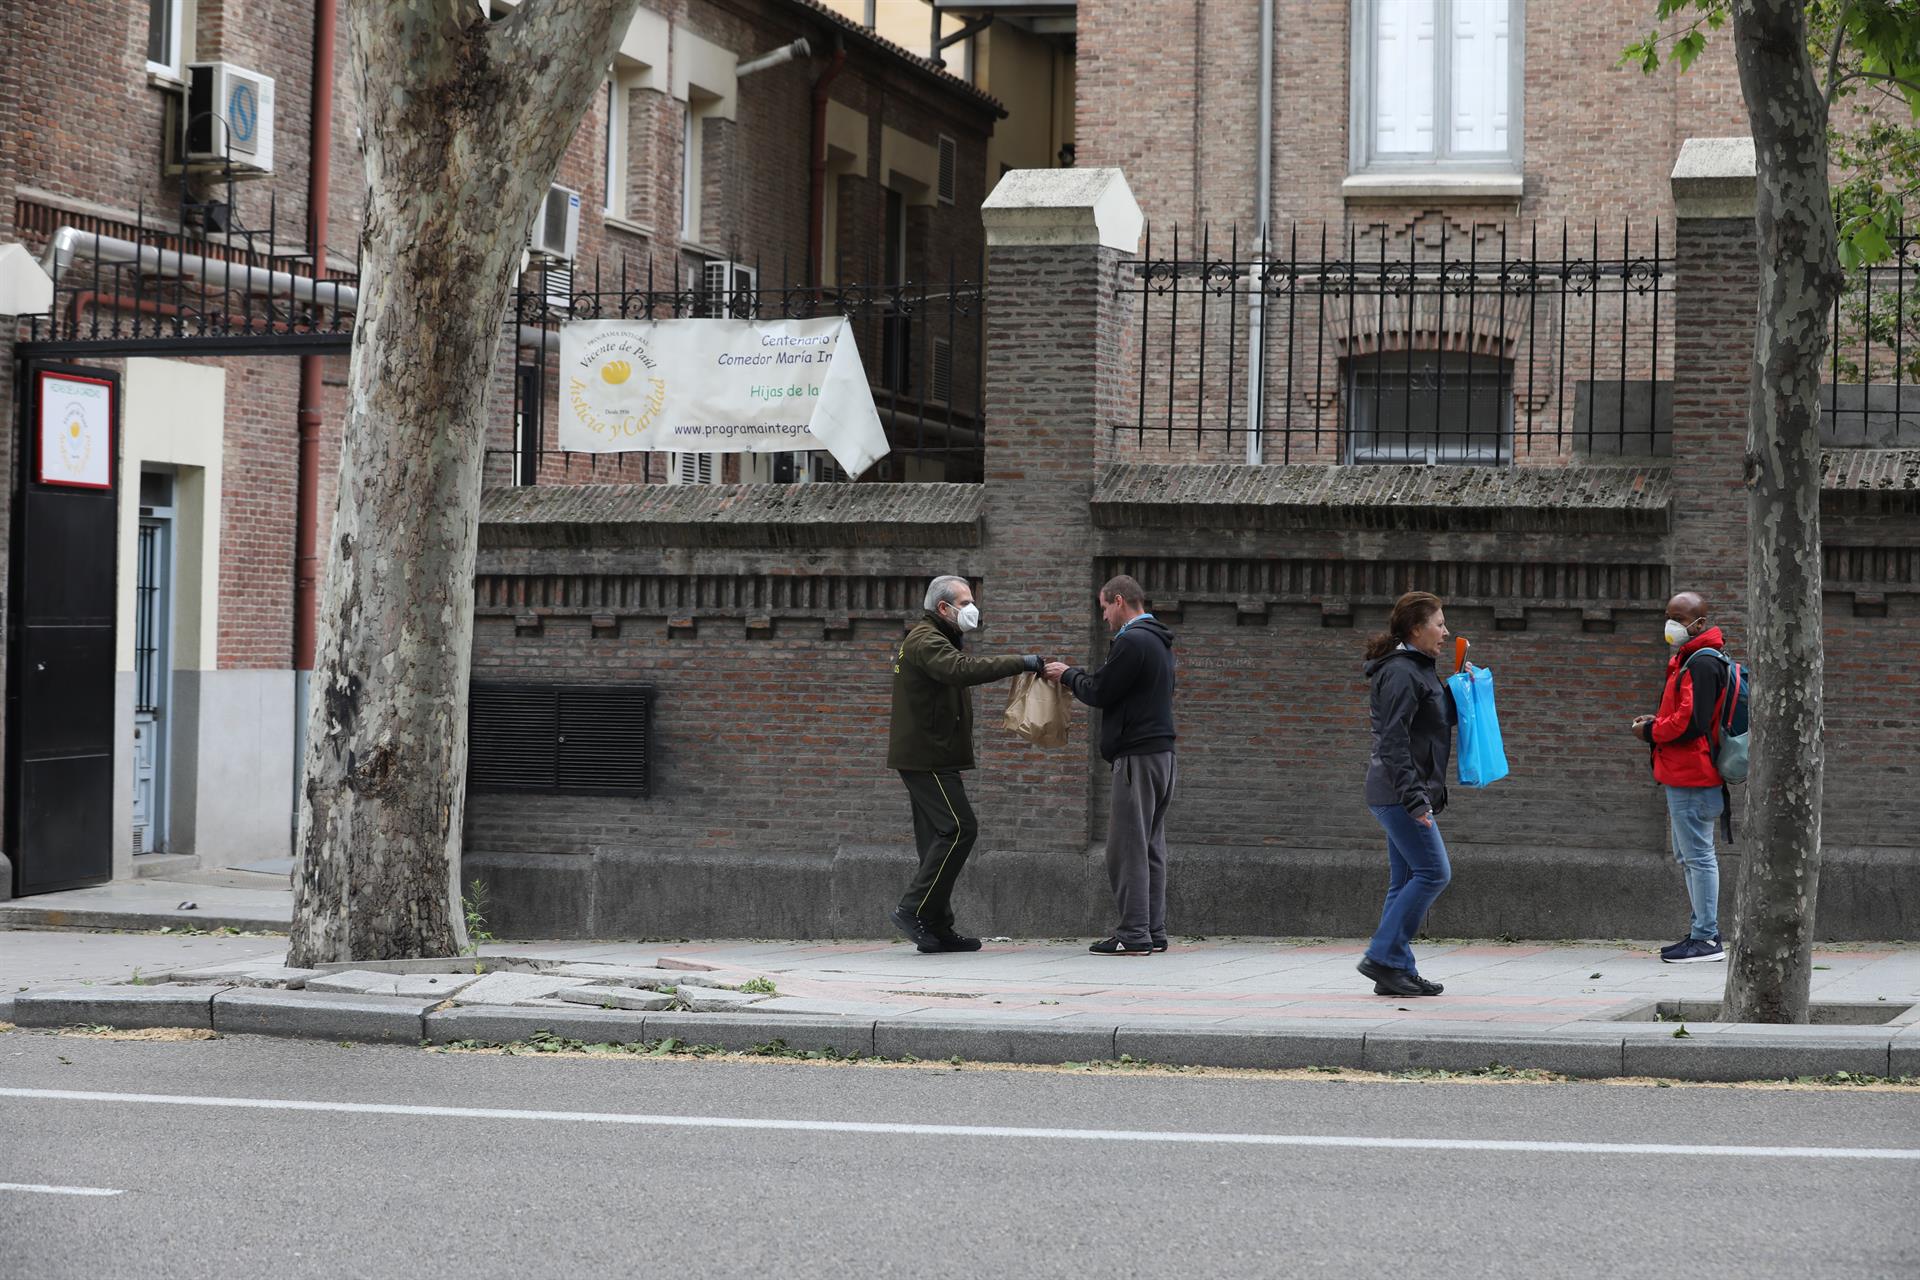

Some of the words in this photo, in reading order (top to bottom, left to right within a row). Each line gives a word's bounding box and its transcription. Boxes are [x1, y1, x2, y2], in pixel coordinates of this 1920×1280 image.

[587, 331, 619, 346] PROGRAMA
[620, 331, 650, 346] INTEGRAL
[761, 334, 830, 346] Centenario
[580, 343, 616, 368] Vicente
[618, 340, 632, 352] de
[633, 346, 657, 369] Paúl
[718, 352, 773, 366] Comedor
[776, 350, 812, 364] María
[750, 384, 783, 400] Hijas
[787, 384, 803, 397] de
[807, 383, 819, 397] la
[570, 375, 606, 433] Justicia
[608, 424, 621, 442] y
[623, 377, 665, 437] Caridad
[674, 422, 811, 438] www.programaintegra
